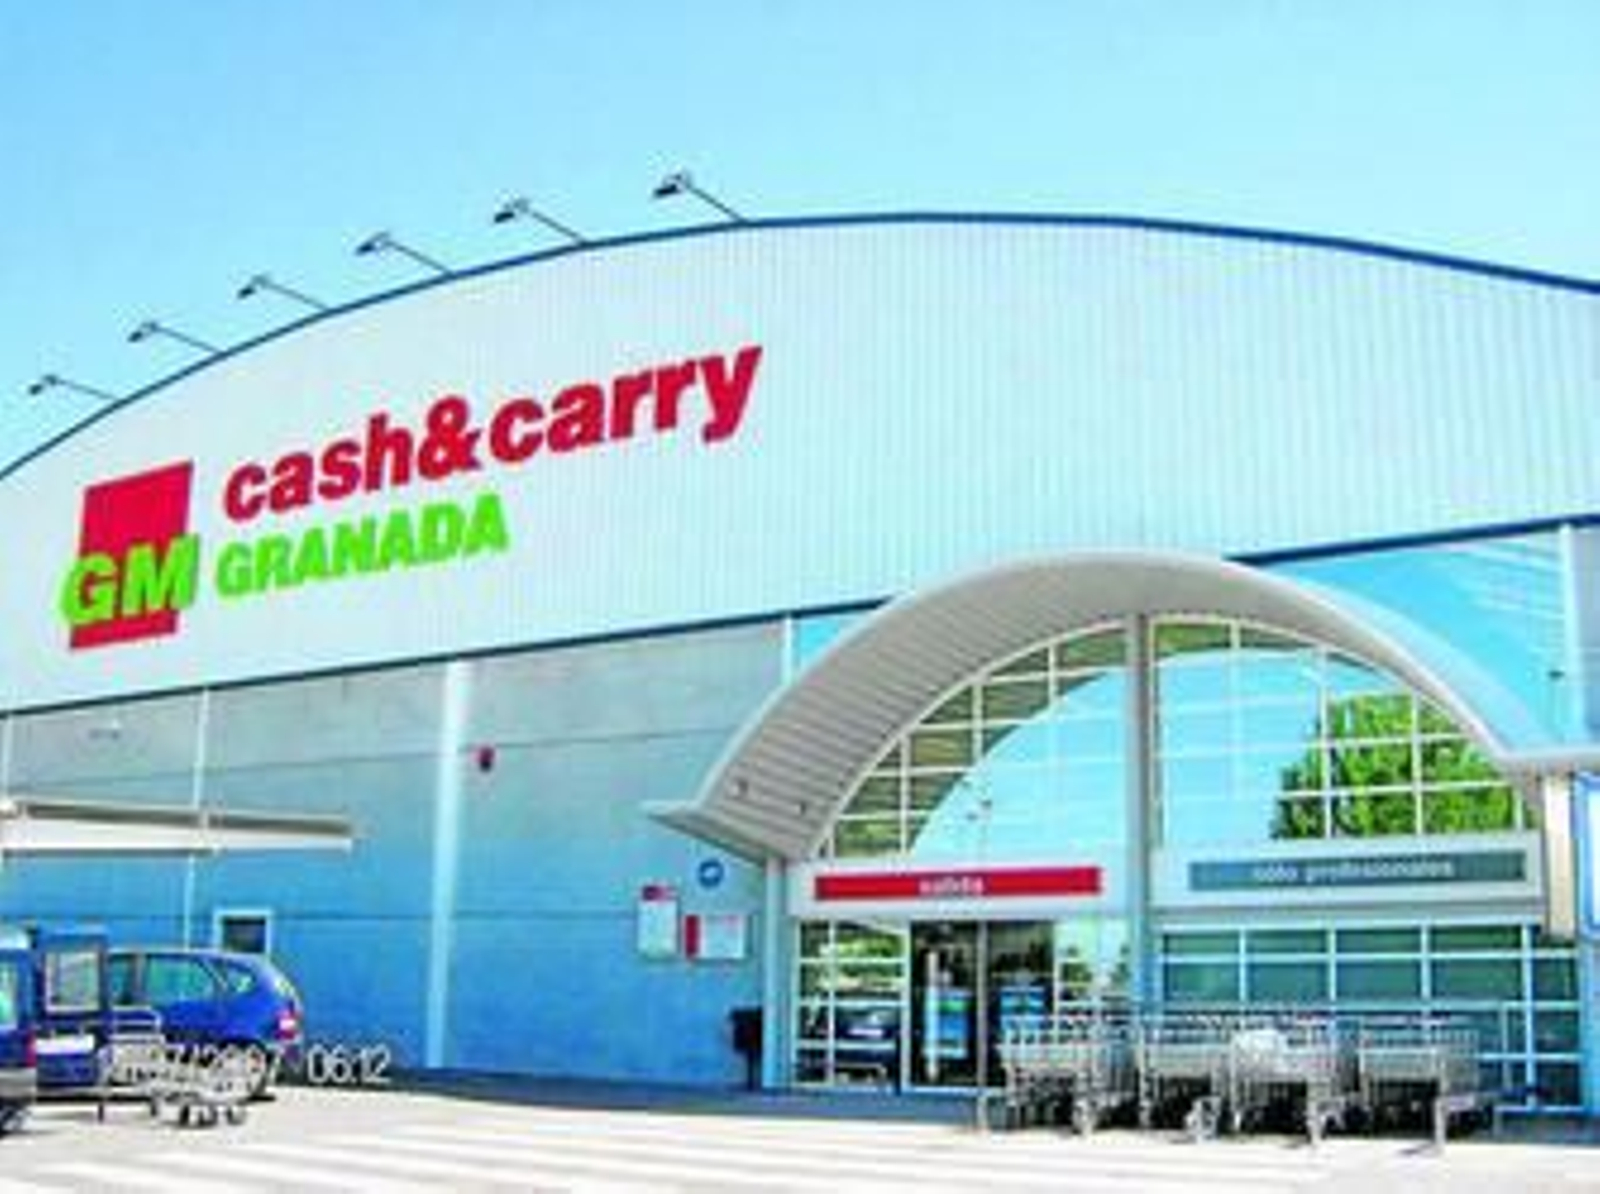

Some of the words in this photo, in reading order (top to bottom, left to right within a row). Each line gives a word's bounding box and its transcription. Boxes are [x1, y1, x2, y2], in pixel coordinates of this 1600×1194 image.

[223, 345, 762, 522] cash&carry
[57, 533, 200, 625] GM
[214, 492, 511, 598] GRANADA
